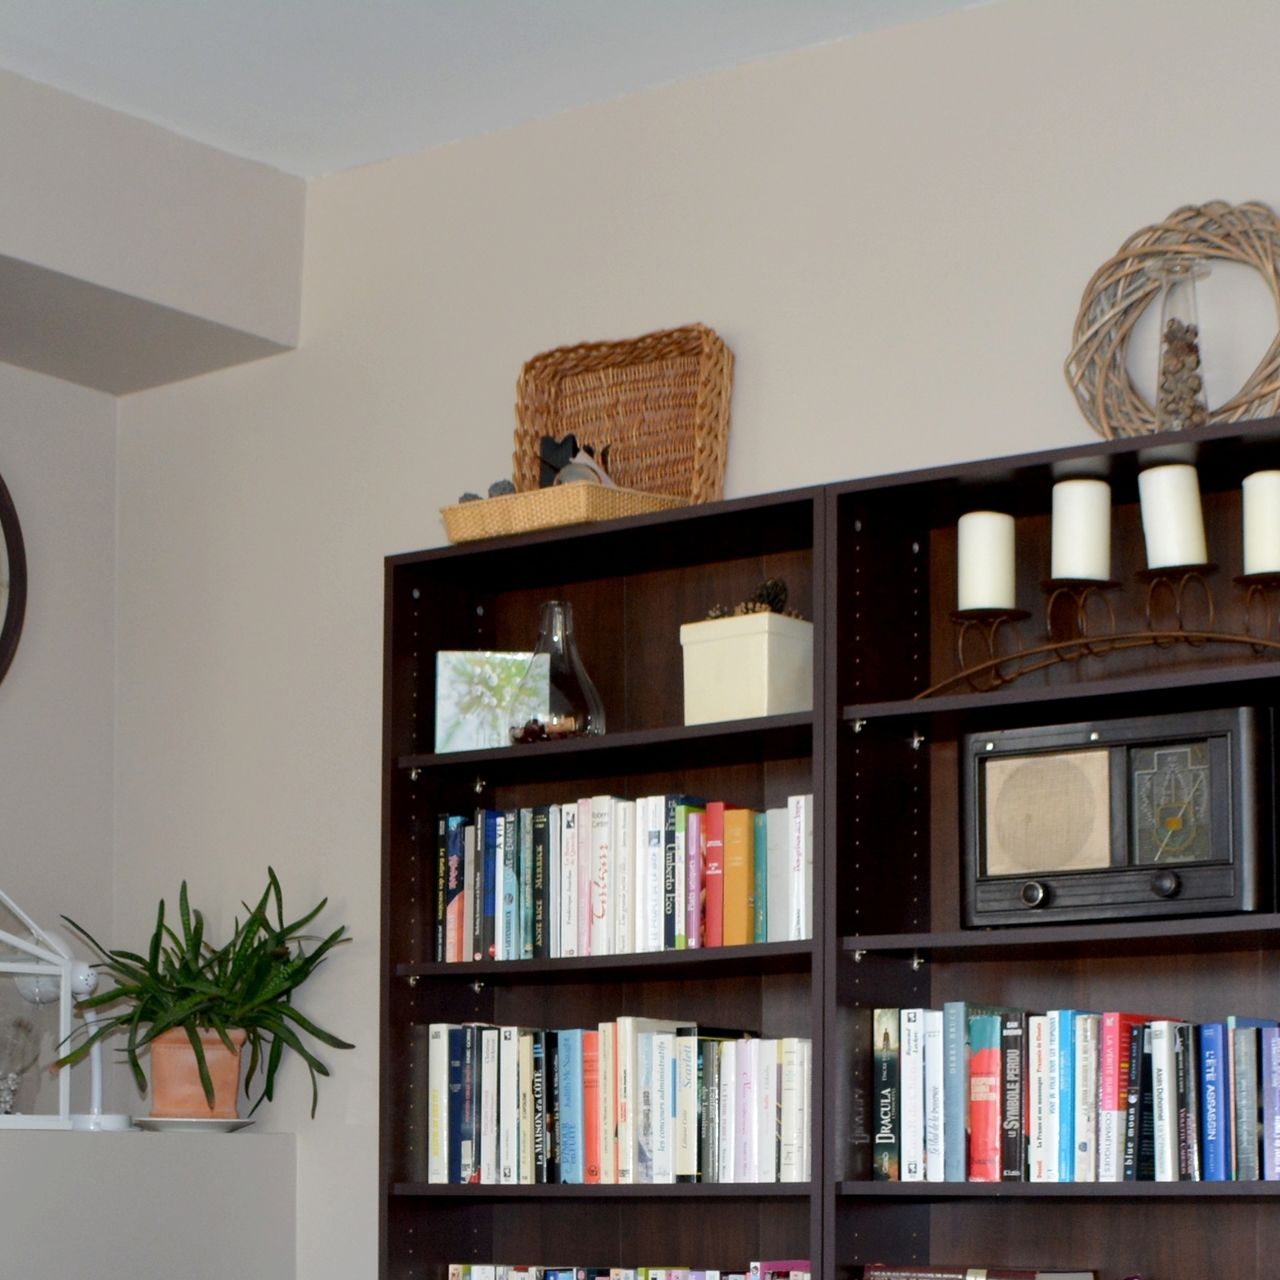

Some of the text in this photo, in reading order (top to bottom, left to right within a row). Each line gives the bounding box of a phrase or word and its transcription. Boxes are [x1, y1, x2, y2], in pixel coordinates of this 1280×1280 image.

[665, 843, 676, 915] Umberto Eco
[1006, 1049, 1020, 1081] PERDU
[1106, 1034, 1113, 1046] LA
[1106, 1048, 1115, 1075] VÉRITÉ
[657, 1040, 667, 1100] administratifs
[682, 1044, 693, 1089] Scarlett
[875, 1087, 896, 1144] DRACULA
[1003, 1083, 1020, 1130] SYMBOLE
[1155, 1067, 1165, 1122] Alain Duhamel
[1205, 1050, 1217, 1140] L'ÉTÉ ASSASSIN
[534, 1112, 544, 1154] MAISON
[658, 1101, 666, 1140] concours
[1103, 1111, 1114, 1173] COSMÉTIQUES
[1124, 1107, 1135, 1166] blue moon
